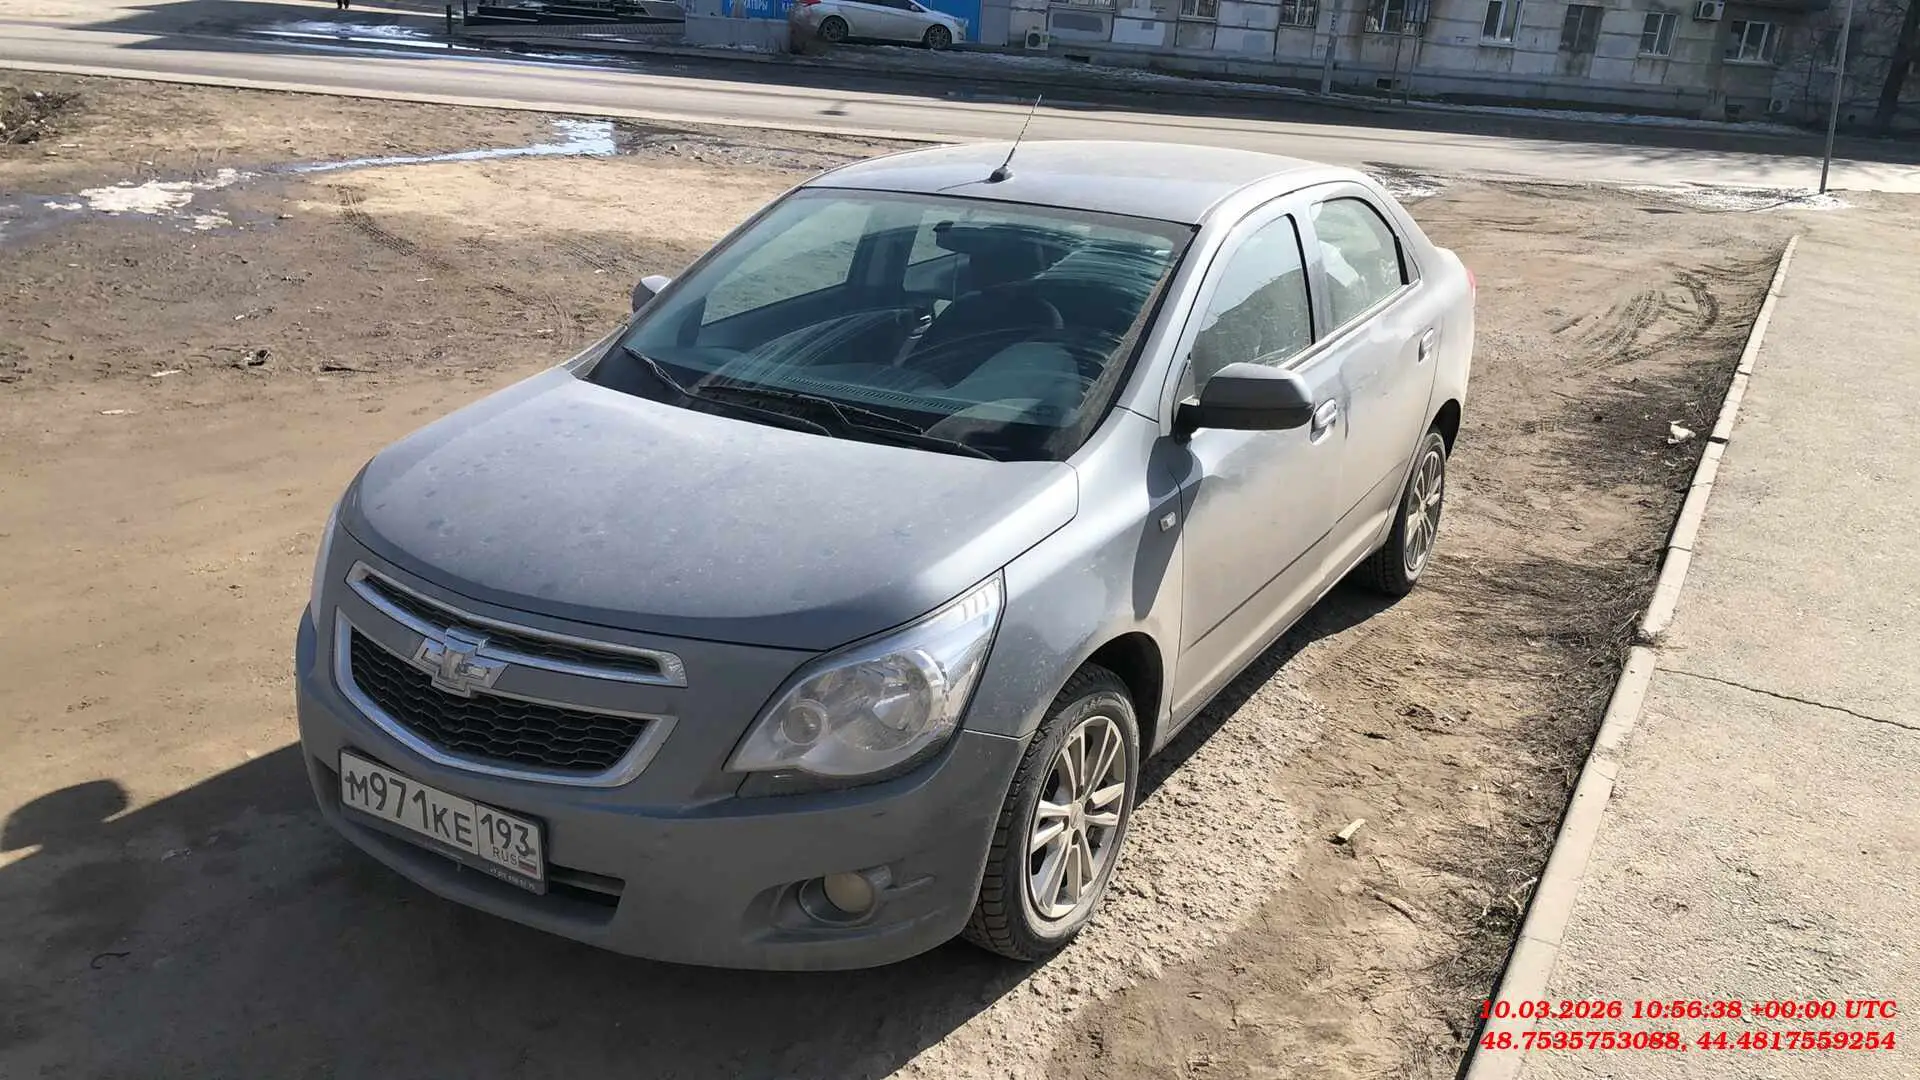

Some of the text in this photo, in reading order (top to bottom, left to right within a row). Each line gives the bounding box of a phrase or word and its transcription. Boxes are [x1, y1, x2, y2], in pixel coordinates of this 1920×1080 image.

[348, 769, 531, 857] М971КЕ 193
[492, 846, 518, 866] RUS
